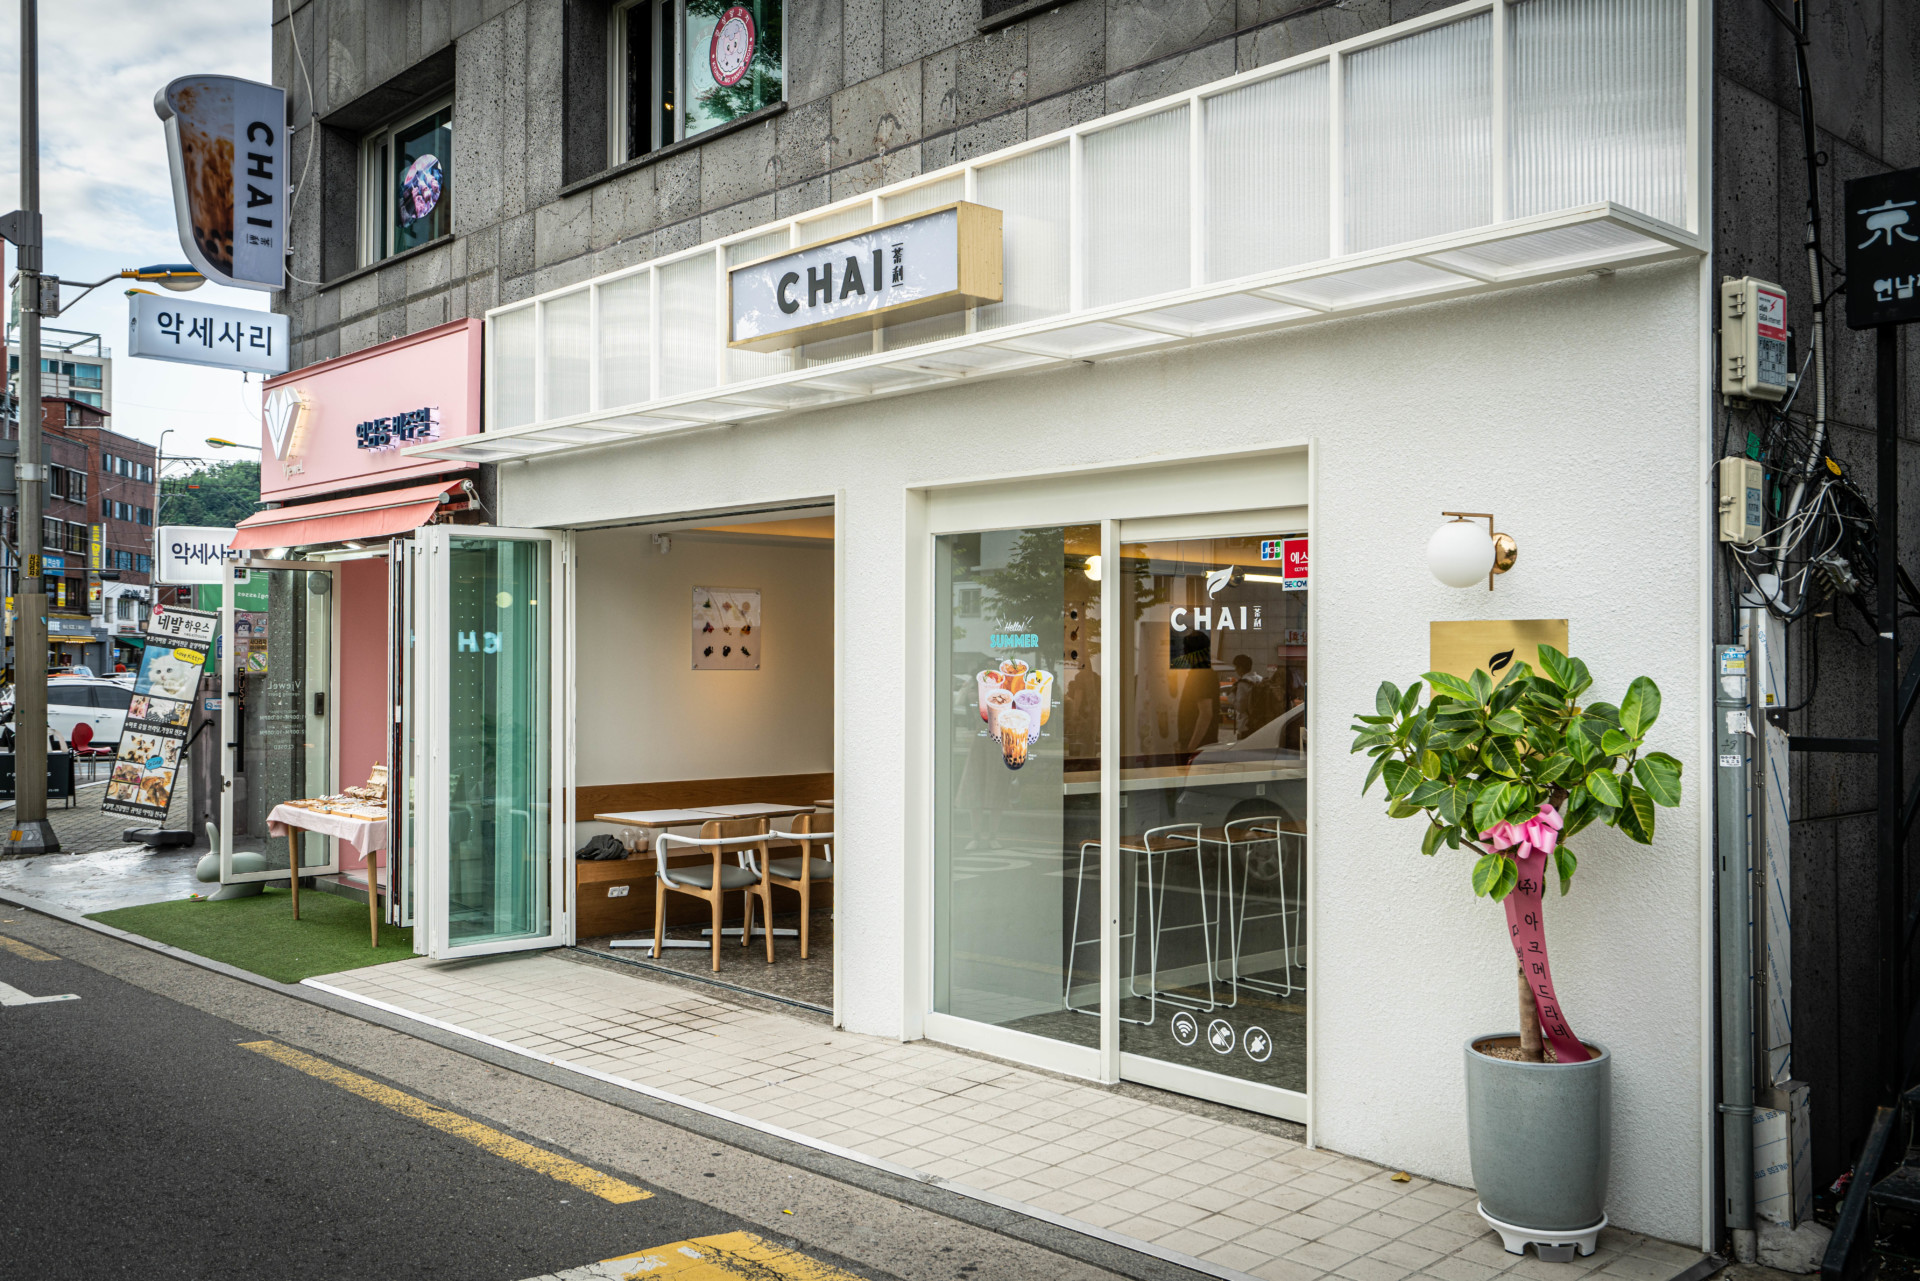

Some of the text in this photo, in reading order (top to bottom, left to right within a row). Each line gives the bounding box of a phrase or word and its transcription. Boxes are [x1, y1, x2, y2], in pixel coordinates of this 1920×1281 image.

[247, 121, 274, 228] CHAI
[776, 248, 883, 315] CHAI
[1873, 273, 1920, 302] 연남
[157, 311, 272, 356] 악세사리
[356, 417, 391, 449] 연남동
[1004, 621, 1025, 632] Hello!
[1170, 606, 1247, 632] CHAI
[990, 633, 1039, 648] SUMMER
